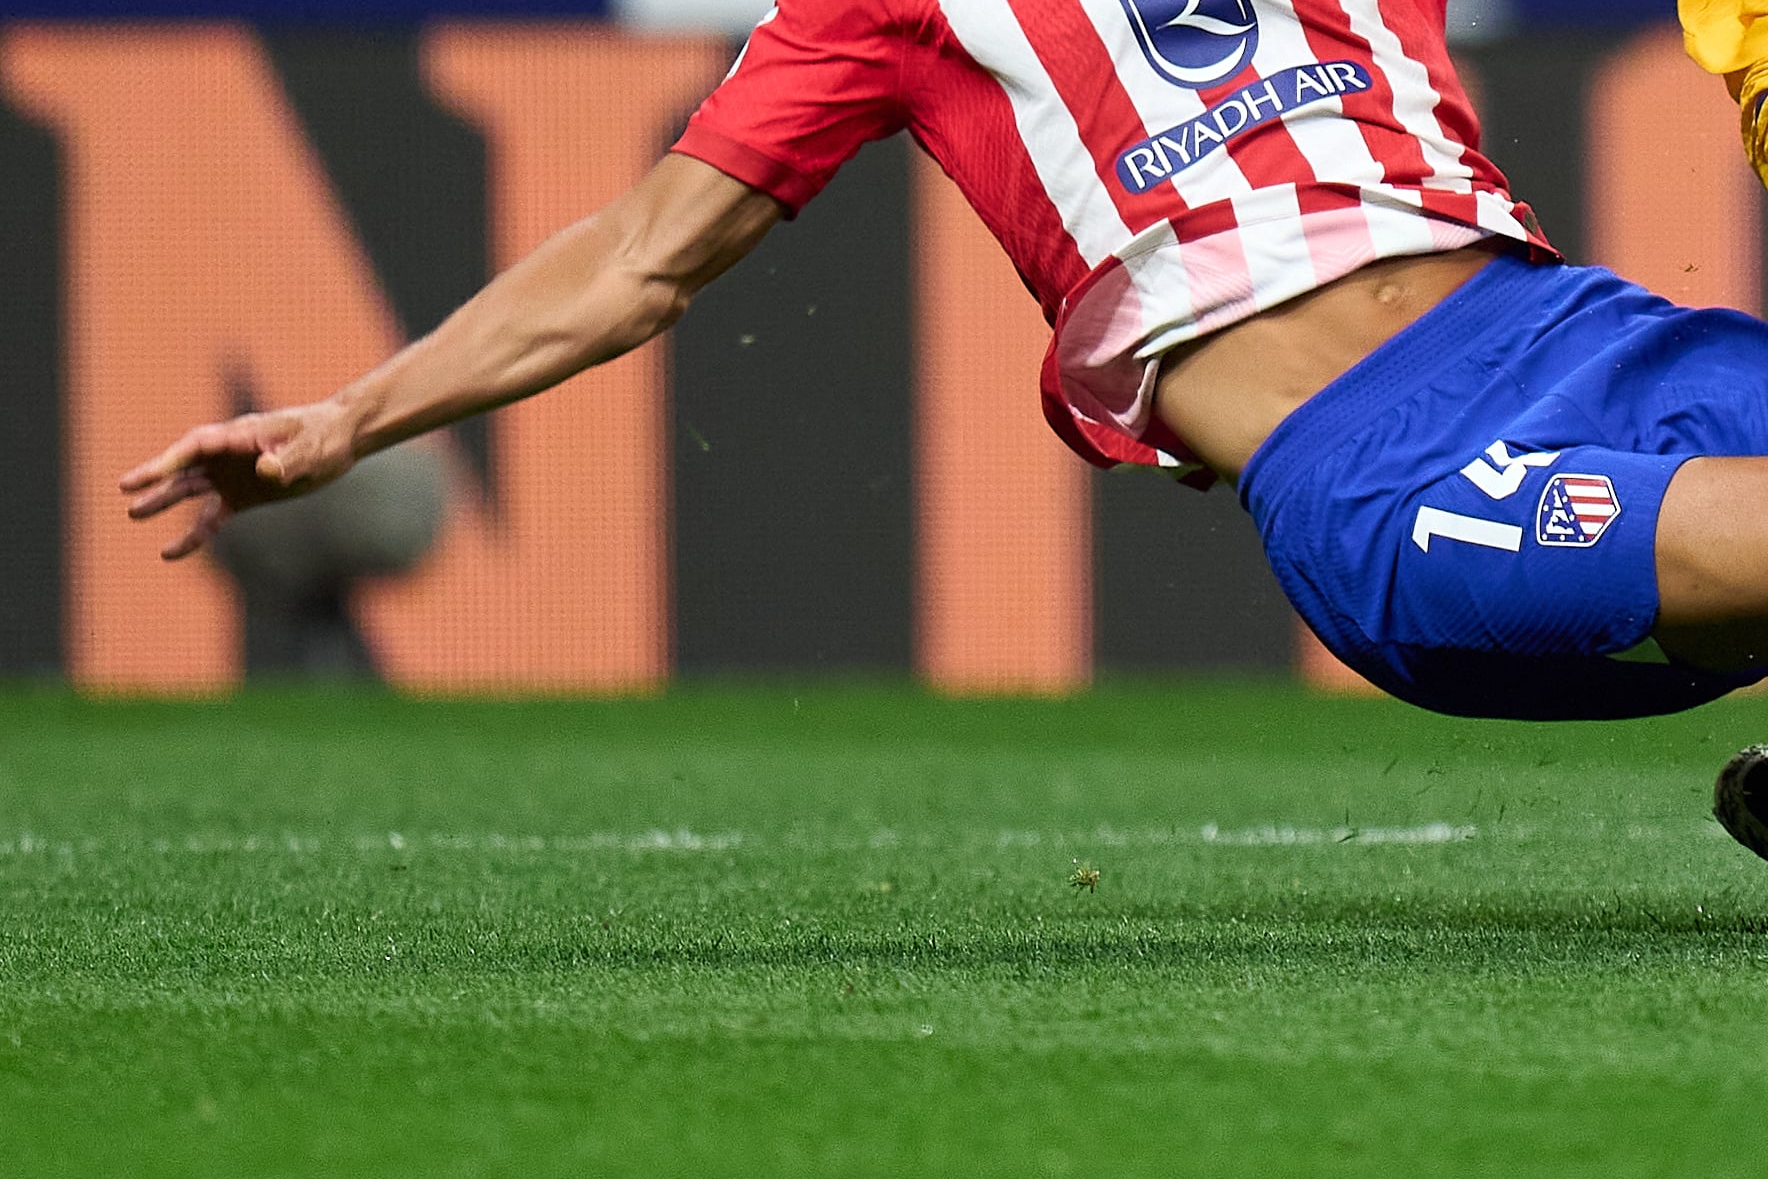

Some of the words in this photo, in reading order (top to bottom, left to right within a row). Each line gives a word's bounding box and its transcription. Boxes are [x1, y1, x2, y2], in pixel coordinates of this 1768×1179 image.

[1123, 80, 1284, 190] RIYADH
[1295, 63, 1367, 103] AIR
[1412, 439, 1561, 553] 14
